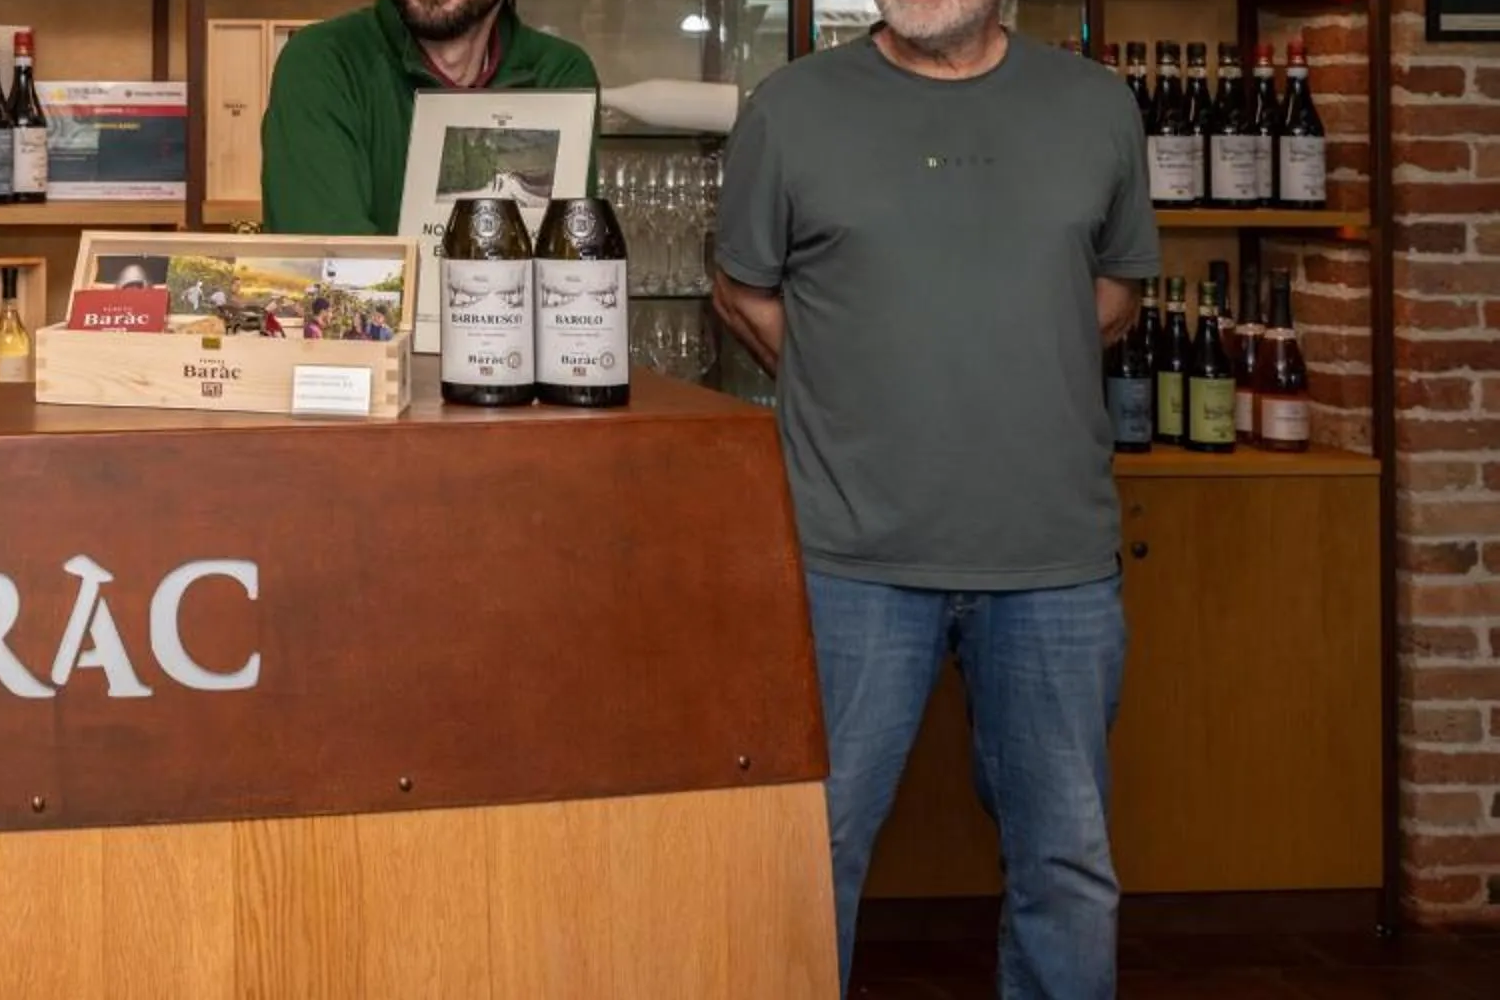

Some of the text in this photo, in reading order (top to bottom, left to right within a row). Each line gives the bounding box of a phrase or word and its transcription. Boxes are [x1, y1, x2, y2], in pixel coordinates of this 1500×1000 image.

[83, 311, 150, 328] Baràc
[451, 313, 523, 325] BARBARESCO
[555, 314, 603, 326] BAROLO
[183, 364, 242, 380] Baràc
